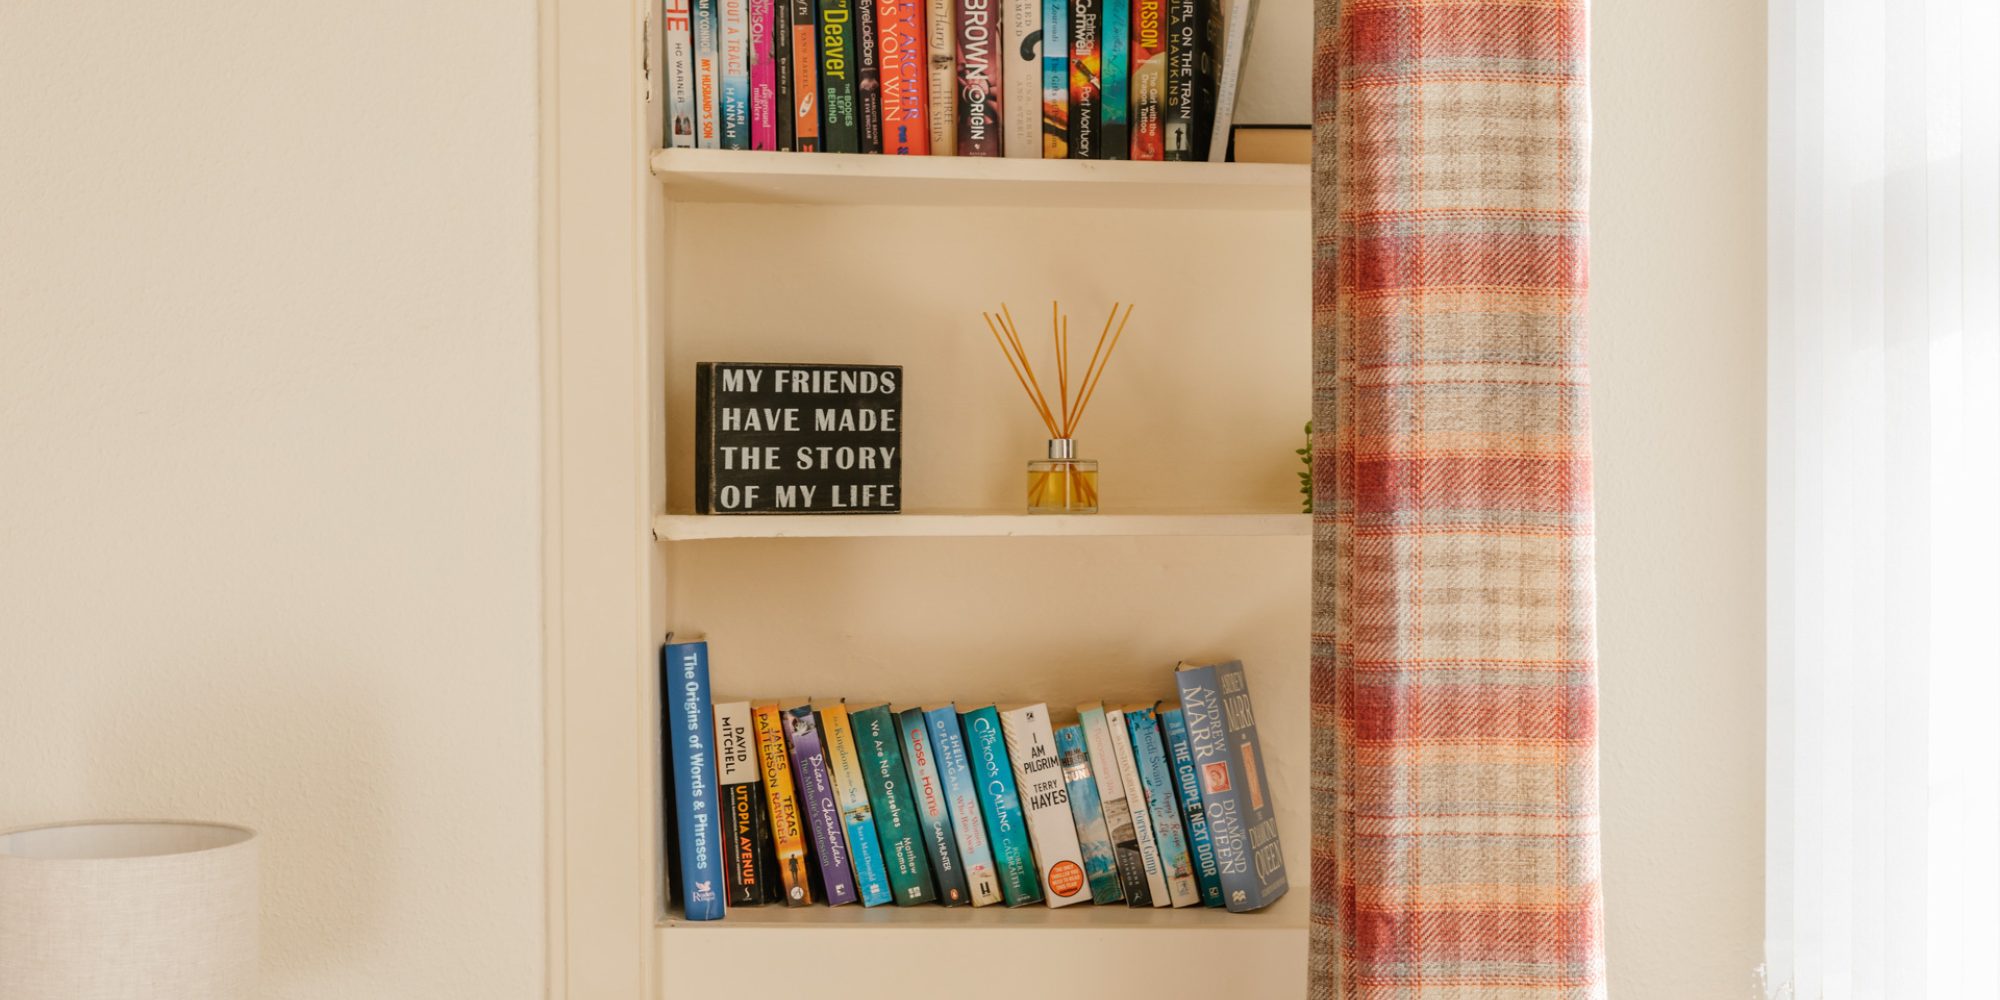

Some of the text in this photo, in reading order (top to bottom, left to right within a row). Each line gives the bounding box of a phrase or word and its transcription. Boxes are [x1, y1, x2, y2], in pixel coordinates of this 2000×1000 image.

[799, 7, 808, 16] Pi
[930, 9, 952, 50] Harry
[1074, 0, 1092, 56] Cornwell
[1086, 13, 1097, 50] Patricia
[1140, 2, 1158, 48] RSSON
[728, 39, 741, 75] TRACE
[823, 10, 849, 80] Deaver
[881, 24, 899, 70] YOU
[964, 0, 989, 80] BROWN
[1181, 27, 1193, 47] ON
[675, 43, 685, 104] HC WARNER
[899, 33, 920, 121] ARCHER
[1169, 34, 1180, 107] HAWKINS
[1181, 50, 1192, 77] THE
[701, 59, 713, 138] MY HUSBAND'S SON
[726, 88, 737, 138] HANNAH
[736, 102, 745, 124] MARI
[754, 88, 762, 120] murders
[828, 88, 838, 124] BEHIND
[837, 96, 845, 114] LEFT
[844, 95, 853, 127] BODIES
[884, 76, 901, 122] WIN
[932, 72, 944, 143] LITTLE SHIPS
[943, 90, 953, 126] THREE
[967, 87, 985, 140] ORIGIN
[1140, 74, 1150, 134] Dragon Tattoo
[1149, 72, 1158, 137] The Girl with the
[1180, 80, 1192, 119] TRAIN
[1078, 87, 1092, 157] Port Mortuary
[722, 368, 896, 394] MY FRIENDS
[721, 407, 897, 432] HAVE MADE
[720, 446, 896, 470] THE STORY
[720, 484, 896, 509] OF MY LIFE
[683, 653, 698, 680] The
[684, 682, 702, 731] Origins
[1182, 685, 1214, 761] MARR
[1203, 688, 1227, 753] ANDREW
[689, 735, 704, 750] of
[722, 717, 736, 776] MITCHELL
[735, 727, 747, 763] DAVID
[759, 713, 779, 789] PATTERSON
[770, 728, 786, 772] JAMES
[936, 720, 960, 791] O'FLANAGAN
[950, 734, 966, 772] SHEILA
[987, 728, 997, 743] THE
[1031, 744, 1046, 758] AM
[1032, 732, 1037, 744] I
[1142, 724, 1164, 787] Heidi Swain
[690, 753, 707, 799] Words
[833, 728, 852, 771] Kingdom
[848, 788, 860, 804] Sea
[869, 720, 902, 829] We Are Not Ourselves
[911, 728, 928, 767] Close
[920, 776, 939, 818] Home
[1023, 755, 1060, 775] PILGRIM
[1032, 779, 1058, 794] TERRY
[693, 801, 705, 814] &
[771, 793, 787, 846] RANGER
[783, 795, 798, 838] TEXAS
[800, 759, 812, 777] The
[812, 820, 831, 868] Confession
[809, 754, 846, 868] Diane Chamberlain
[988, 780, 1010, 833] CALLING
[1030, 789, 1068, 811] HAYES
[1153, 806, 1169, 838] for Life
[1162, 791, 1181, 849] Poppy's Recipe
[1173, 740, 1217, 878] THE COUPLE NEXT DOOR
[694, 815, 710, 870] Phrases
[736, 785, 755, 886] UTOPIA AVENUE
[933, 821, 952, 872] CARA HUNTER
[966, 801, 984, 847] The Women
[1133, 808, 1160, 876] Forrest Gump
[1207, 802, 1233, 875] QUEEN
[1222, 798, 1247, 874] DIAMOND
[861, 843, 878, 883] MacDonald
[894, 841, 908, 876] Thomas
[902, 837, 919, 875] Matthew
[1004, 838, 1020, 888] GALBRAITH
[1013, 846, 1025, 875] ROBERT
